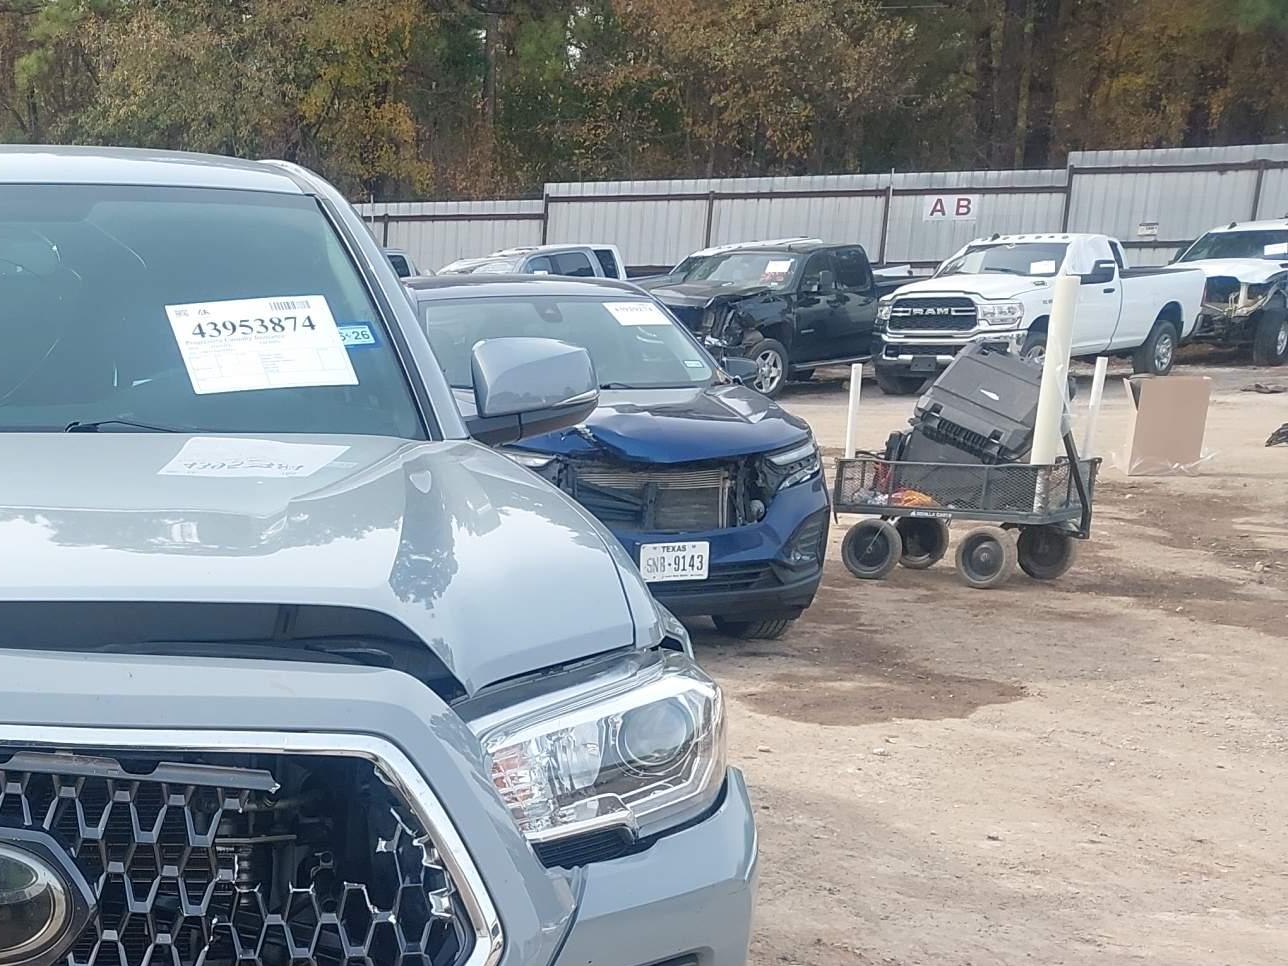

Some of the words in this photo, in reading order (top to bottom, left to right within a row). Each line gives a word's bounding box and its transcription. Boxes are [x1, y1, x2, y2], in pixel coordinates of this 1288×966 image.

[929, 198, 946, 216] A
[955, 198, 972, 216] B
[912, 307, 950, 315] RAM
[192, 315, 316, 338] 43953874
[661, 545, 687, 553] TEXAS
